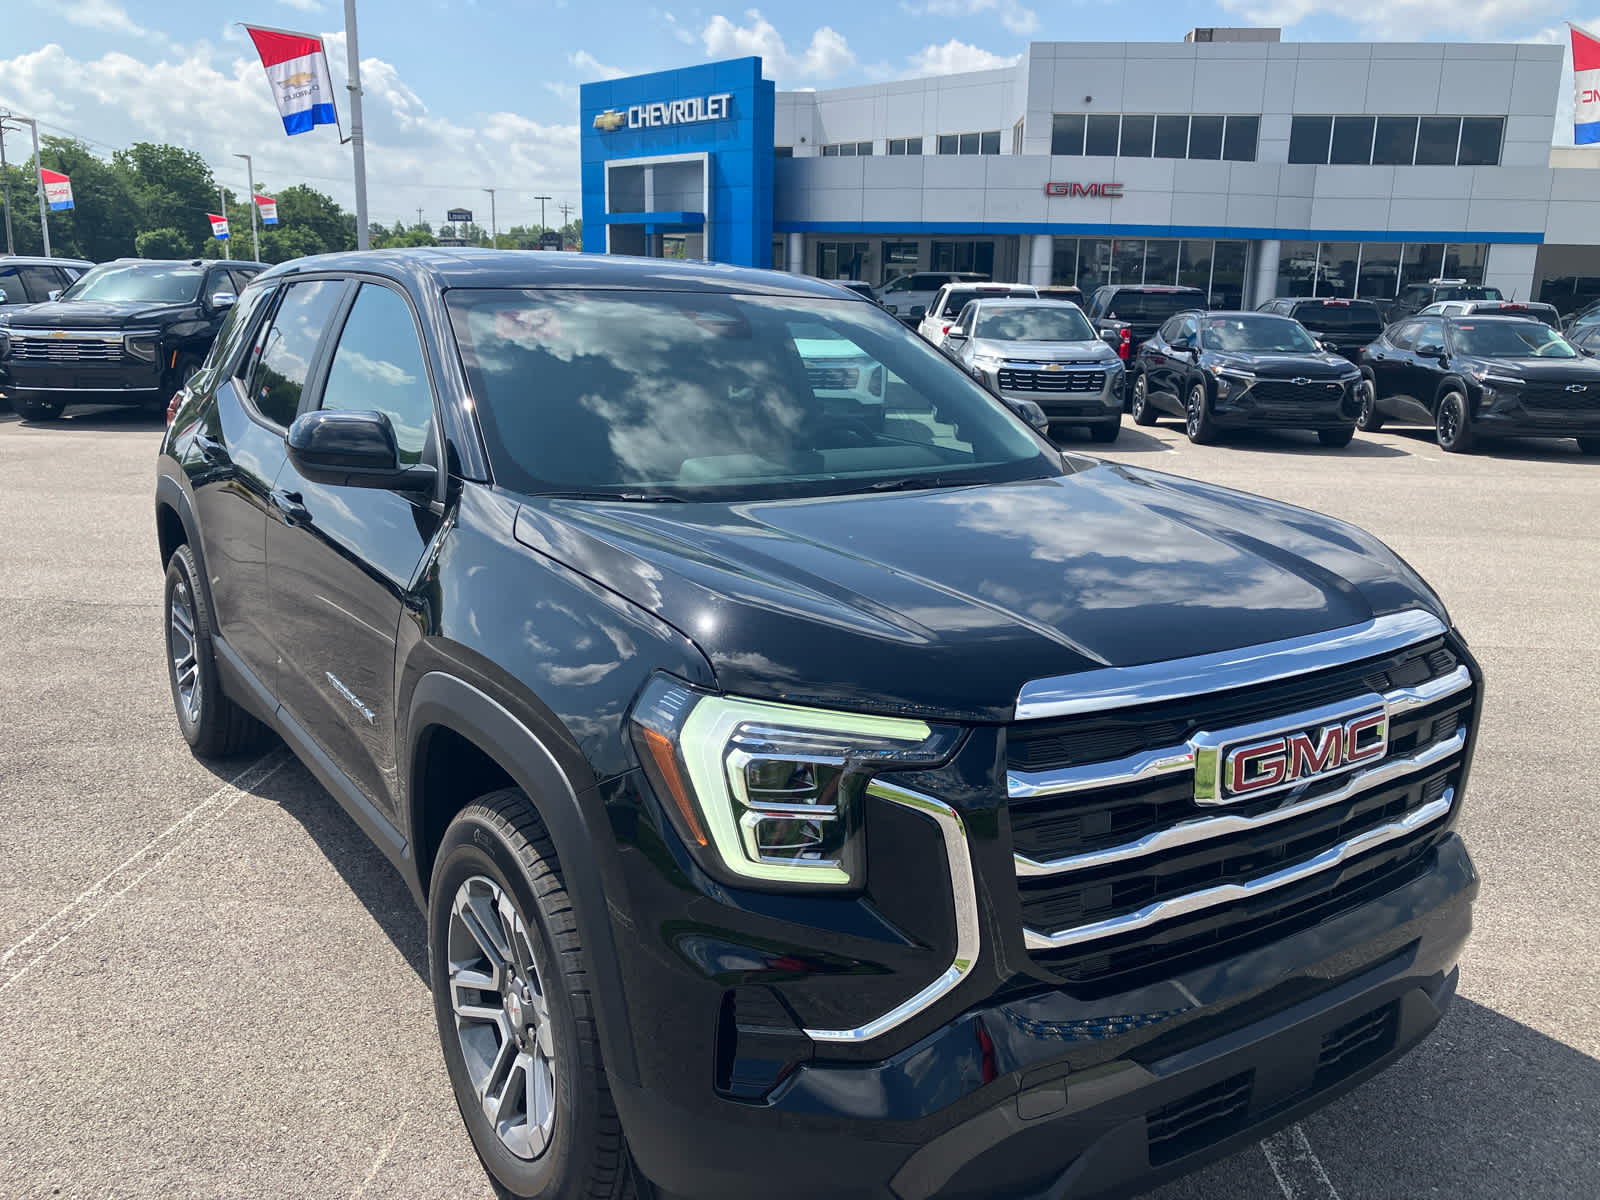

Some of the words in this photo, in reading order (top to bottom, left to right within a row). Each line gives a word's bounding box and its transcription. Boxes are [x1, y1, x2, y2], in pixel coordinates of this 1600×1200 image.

[628, 93, 733, 128] CHEVROLET
[1045, 181, 1124, 199] GMC
[1226, 709, 1387, 794] GMC
